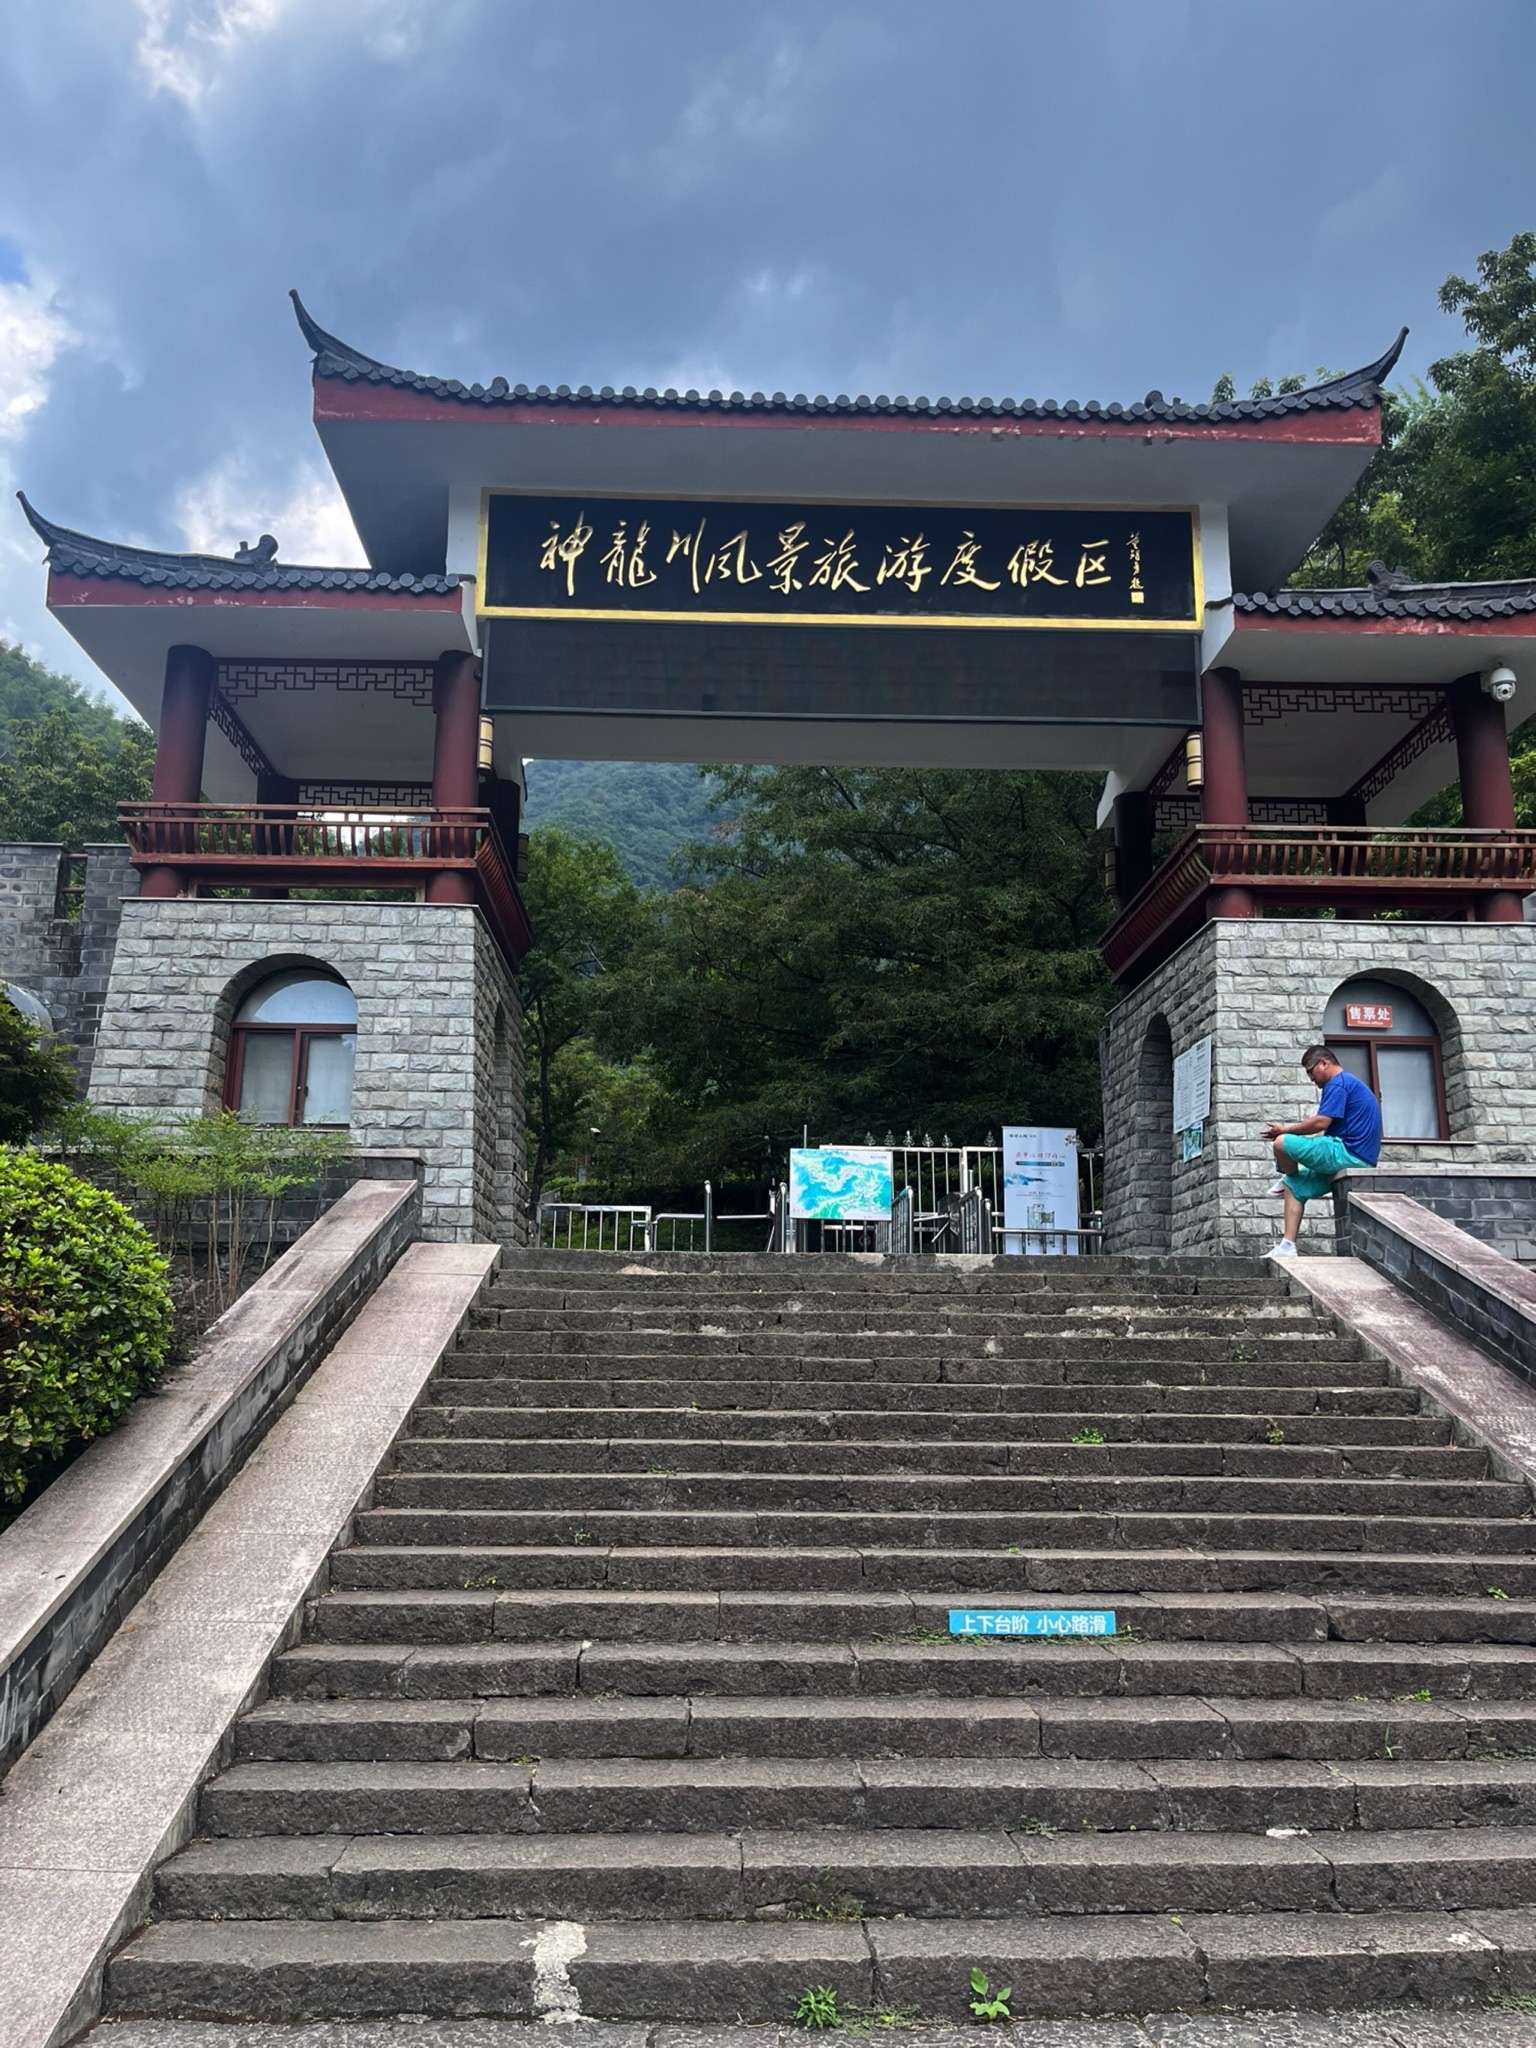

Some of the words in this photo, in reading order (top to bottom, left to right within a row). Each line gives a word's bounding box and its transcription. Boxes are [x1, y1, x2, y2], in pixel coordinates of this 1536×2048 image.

[1349, 1006, 1390, 1020] 售票处
[959, 1614, 1030, 1633] 上下台阶
[1037, 1614, 1106, 1634] 小心路滑
